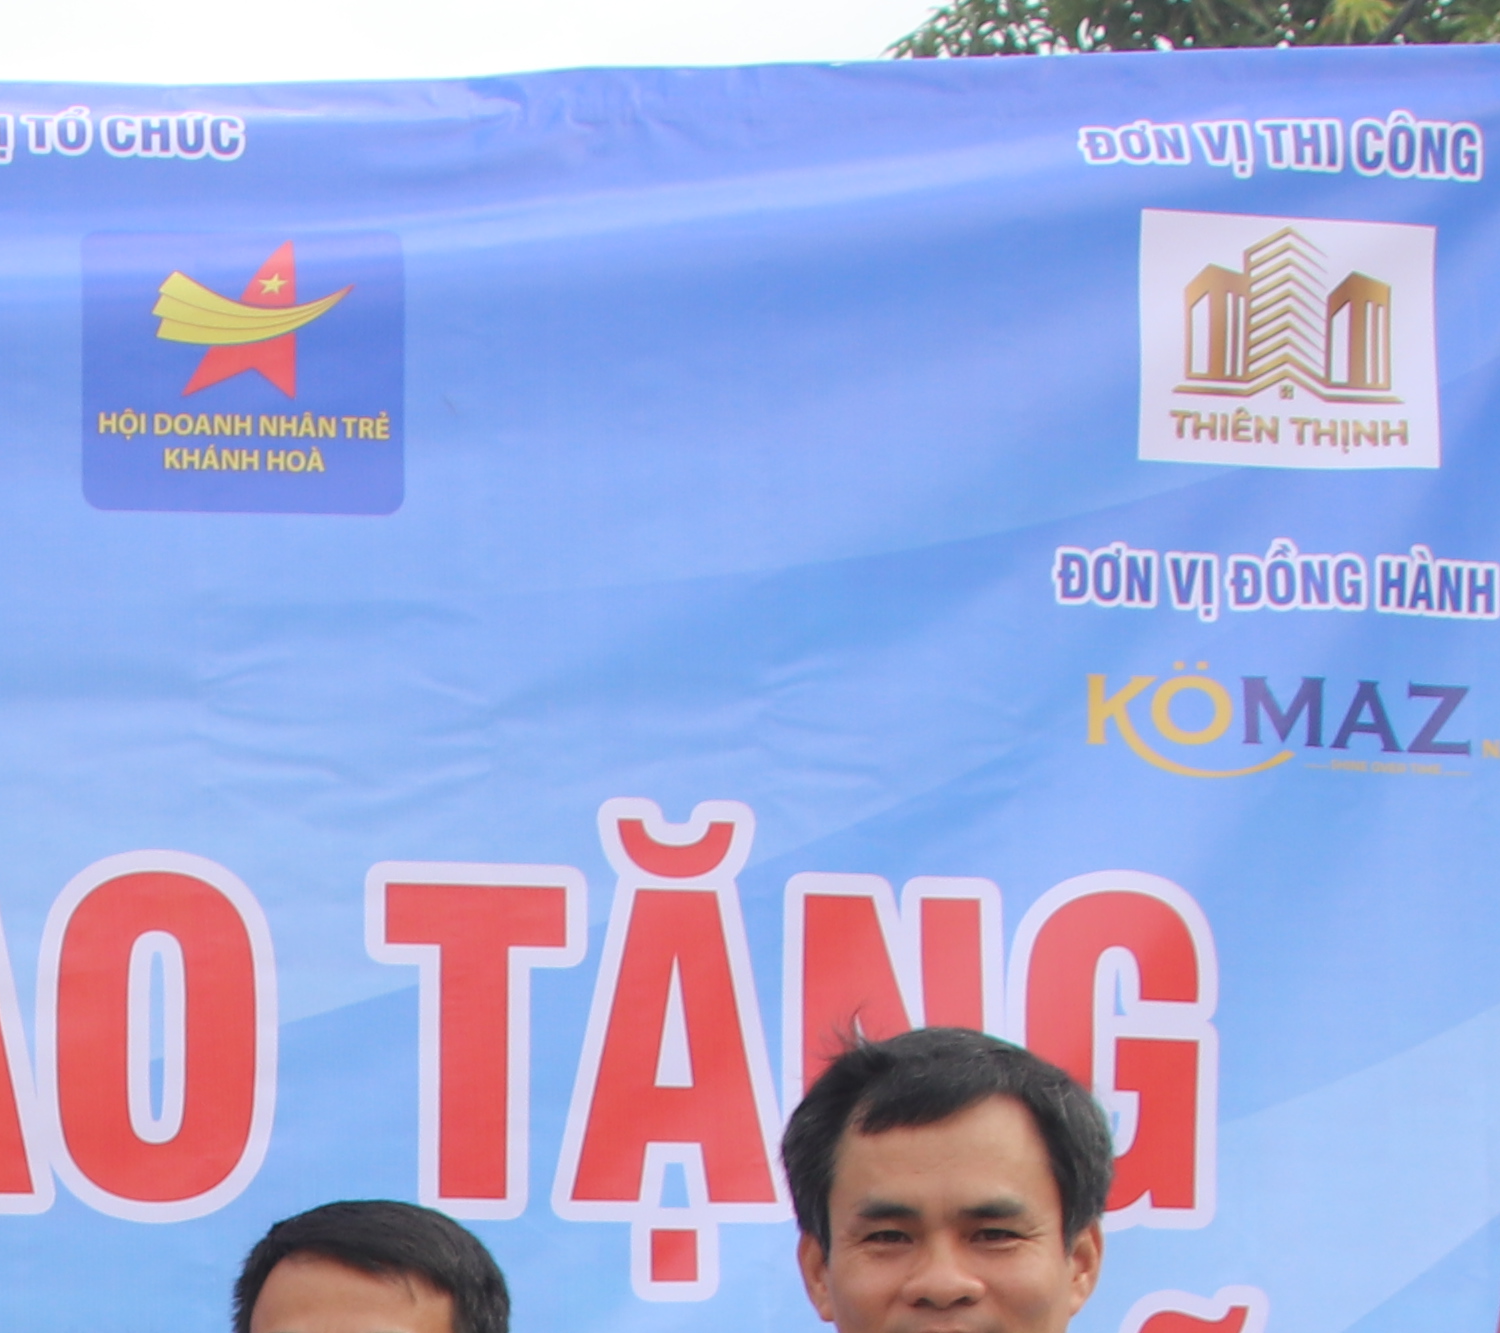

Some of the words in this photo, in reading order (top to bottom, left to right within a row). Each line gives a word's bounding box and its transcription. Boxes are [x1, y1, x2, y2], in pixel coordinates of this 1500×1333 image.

[108, 114, 242, 160] CHỨC
[1083, 124, 1188, 160] ĐƠN
[1196, 125, 1249, 176] VỊ
[1262, 122, 1338, 168] THI
[1356, 112, 1479, 176] CÔNG
[98, 408, 148, 442] HỘI
[154, 414, 252, 441] DOANH
[259, 408, 337, 439] NHÂN
[342, 408, 390, 441] TRẺ
[1170, 409, 1279, 444] THIÊN
[1289, 416, 1408, 454] THỊNH
[164, 442, 259, 472] KHÁNH
[266, 442, 325, 473] HOÀ
[1058, 549, 1153, 602] ĐƠN
[1172, 558, 1215, 616] VỊ
[1229, 540, 1361, 605] ĐỒNG
[1379, 549, 1496, 615] HÀNH
[1085, 661, 1471, 756] KÖMAZ
